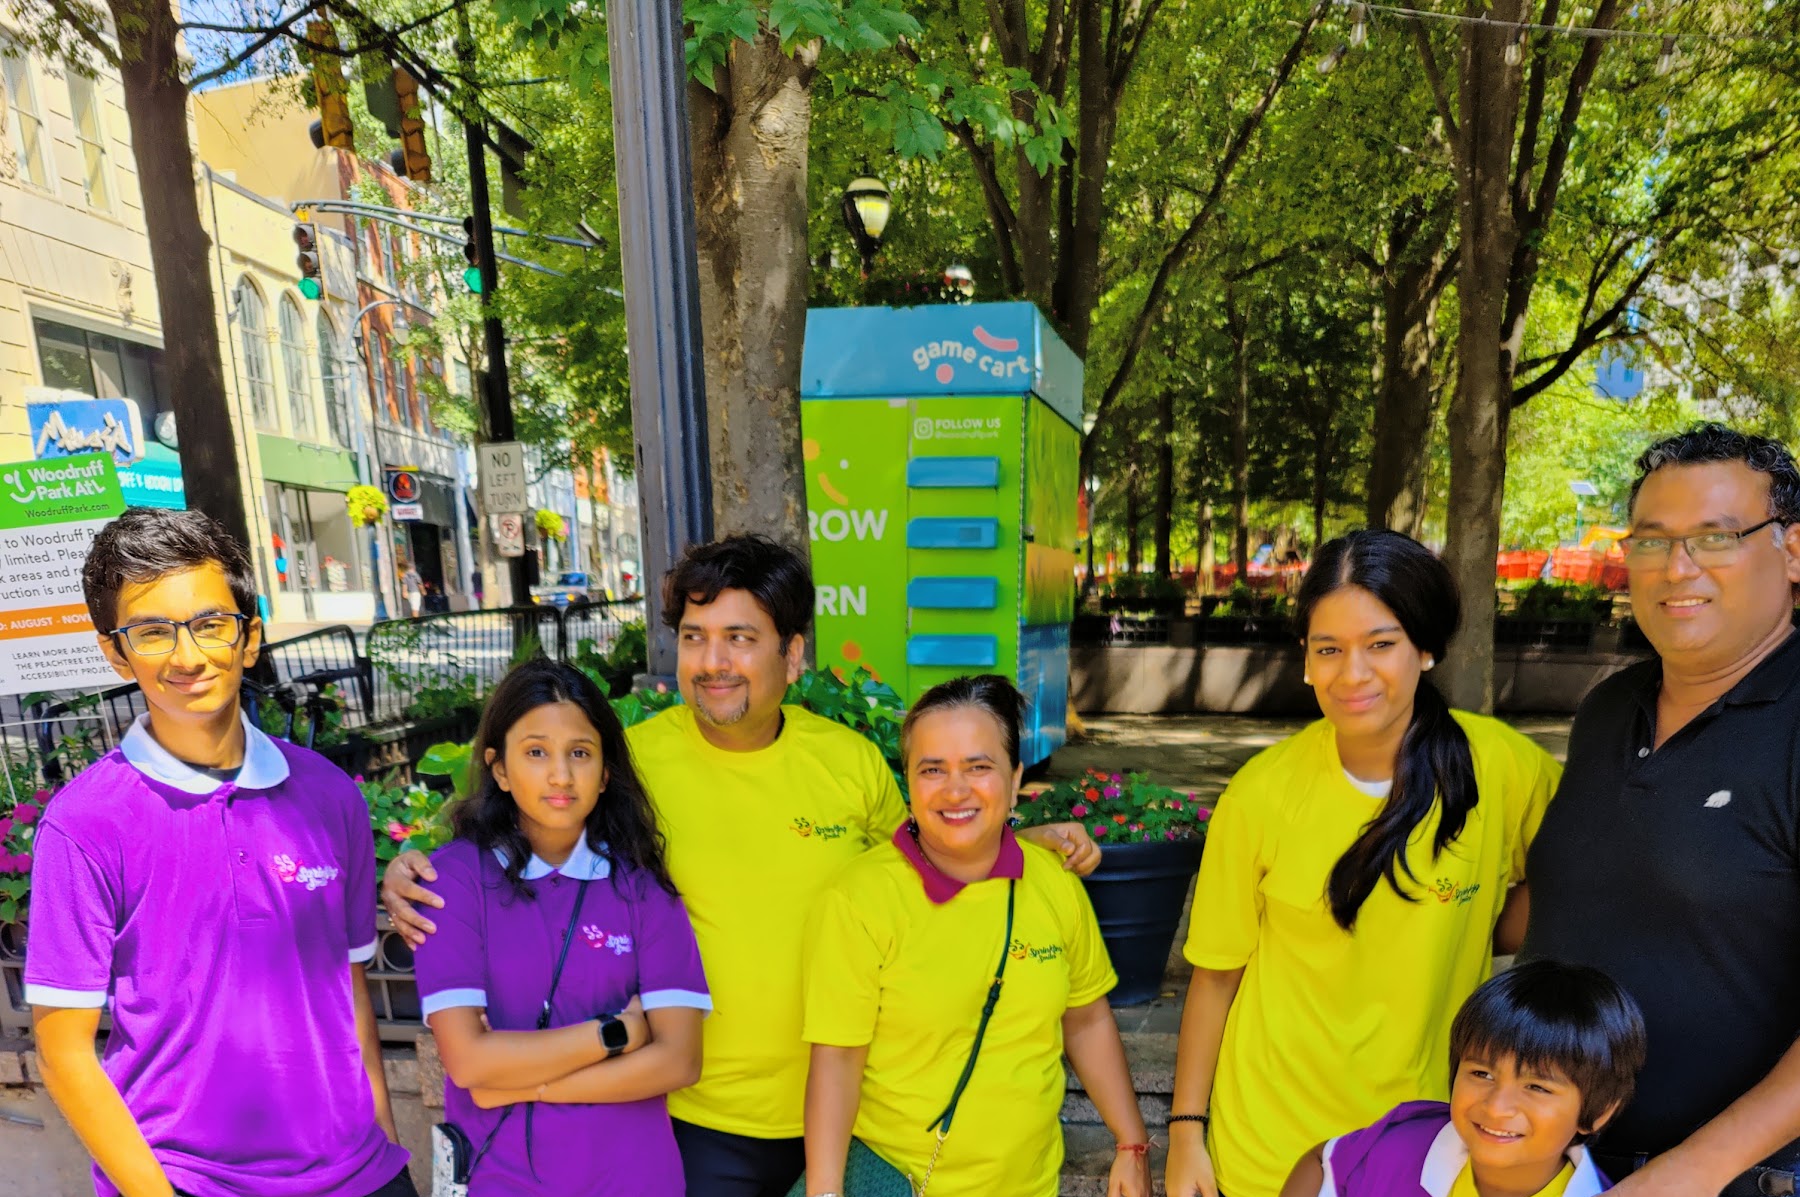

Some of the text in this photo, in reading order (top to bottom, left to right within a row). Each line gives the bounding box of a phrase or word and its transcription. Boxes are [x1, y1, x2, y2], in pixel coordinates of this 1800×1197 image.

[912, 340, 1030, 378] game cart
[935, 417, 1001, 430] FOLLOW US
[491, 452, 512, 468] NO
[27, 460, 105, 484] Woodruff
[490, 472, 517, 487] LEFT
[37, 482, 74, 501] Park
[489, 492, 521, 506] TURN
[25, 504, 110, 519] WoodruffPark.com
[5, 539, 19, 549] to
[21, 529, 84, 548] Woodruff
[5, 549, 89, 567] limited. Plea
[10, 571, 43, 583] areas
[47, 566, 70, 579] and
[0, 587, 41, 600] uction
[43, 585, 54, 596] is
[11, 617, 53, 630] AUGUST
[12, 646, 98, 660] LEARN MORE ABOUT
[16, 656, 108, 671] THE PEACHTREE STRE
[21, 670, 79, 681] ACCESSIBILITY
